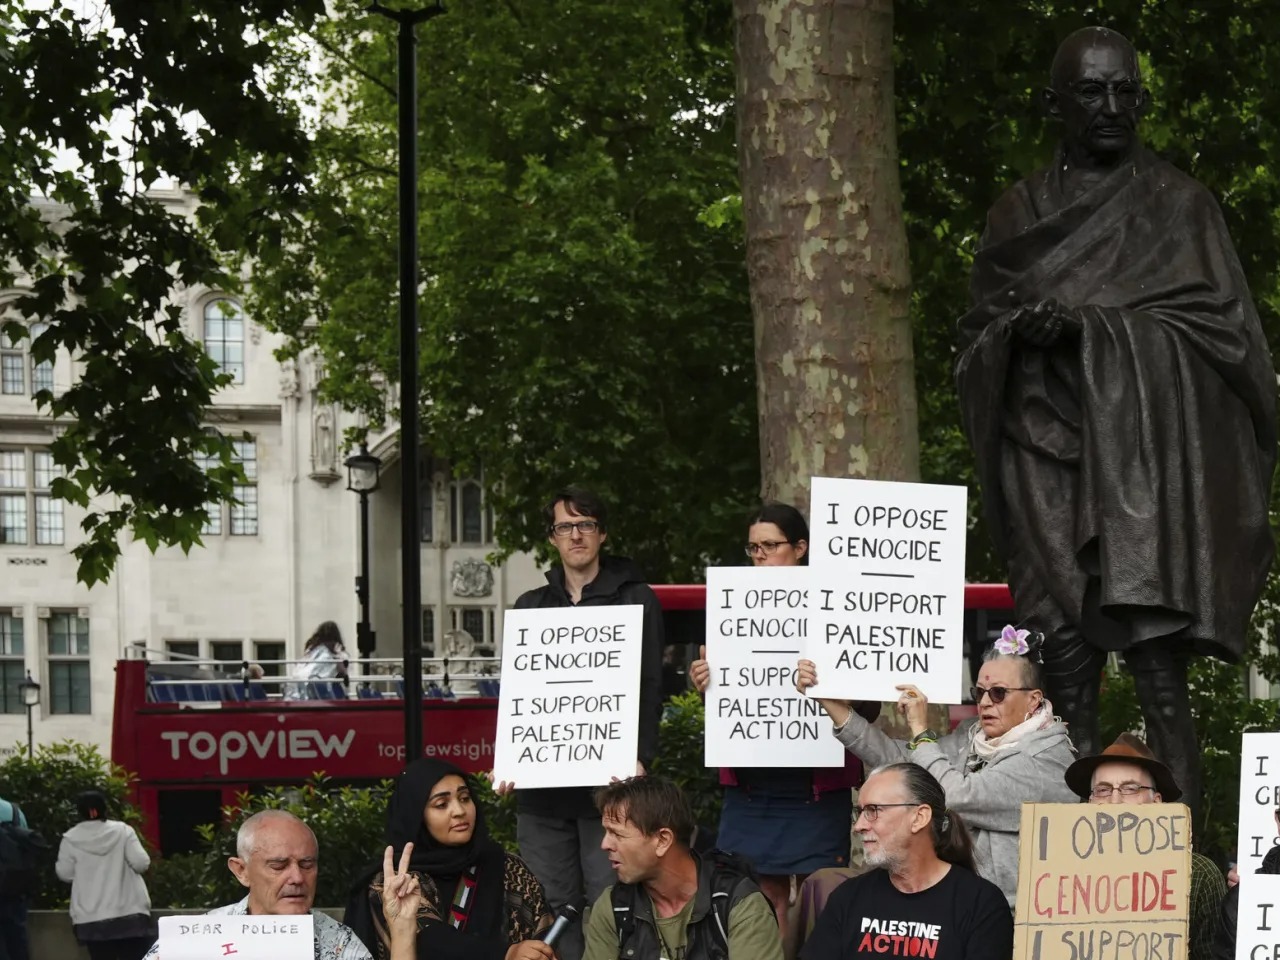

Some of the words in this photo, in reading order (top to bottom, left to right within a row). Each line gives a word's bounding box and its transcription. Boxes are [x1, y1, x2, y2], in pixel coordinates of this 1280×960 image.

[826, 502, 840, 525] I
[854, 505, 949, 531] OPPOSE
[828, 535, 942, 562] GENOCIDE
[721, 589, 734, 608] I
[745, 589, 808, 609] OPPOS
[820, 589, 835, 611] I
[843, 591, 947, 616] SUPPORT
[516, 628, 529, 647] I
[540, 624, 626, 645] OPPOSE
[720, 618, 808, 638] GENOCI
[825, 623, 946, 650] PALESTINE
[513, 650, 622, 671] GENOCIDE
[836, 649, 929, 674] ACTION
[719, 668, 730, 686] I
[738, 667, 799, 687] SUPP
[510, 698, 524, 717] I
[531, 694, 626, 714] SUPPORT
[511, 721, 621, 744] PALESTINE
[729, 721, 818, 740] ACTION
[518, 743, 604, 764] ACTION
[1255, 756, 1269, 776] I
[1039, 816, 1049, 861] I
[1071, 811, 1187, 859] OPPOSE
[1250, 836, 1264, 857] I
[1034, 869, 1178, 918] GENOCIDE
[1256, 903, 1274, 931] I
[179, 924, 223, 935] DEAR
[860, 917, 942, 941] PALESTINE
[222, 942, 238, 956] I
[858, 932, 939, 959] ACTION
